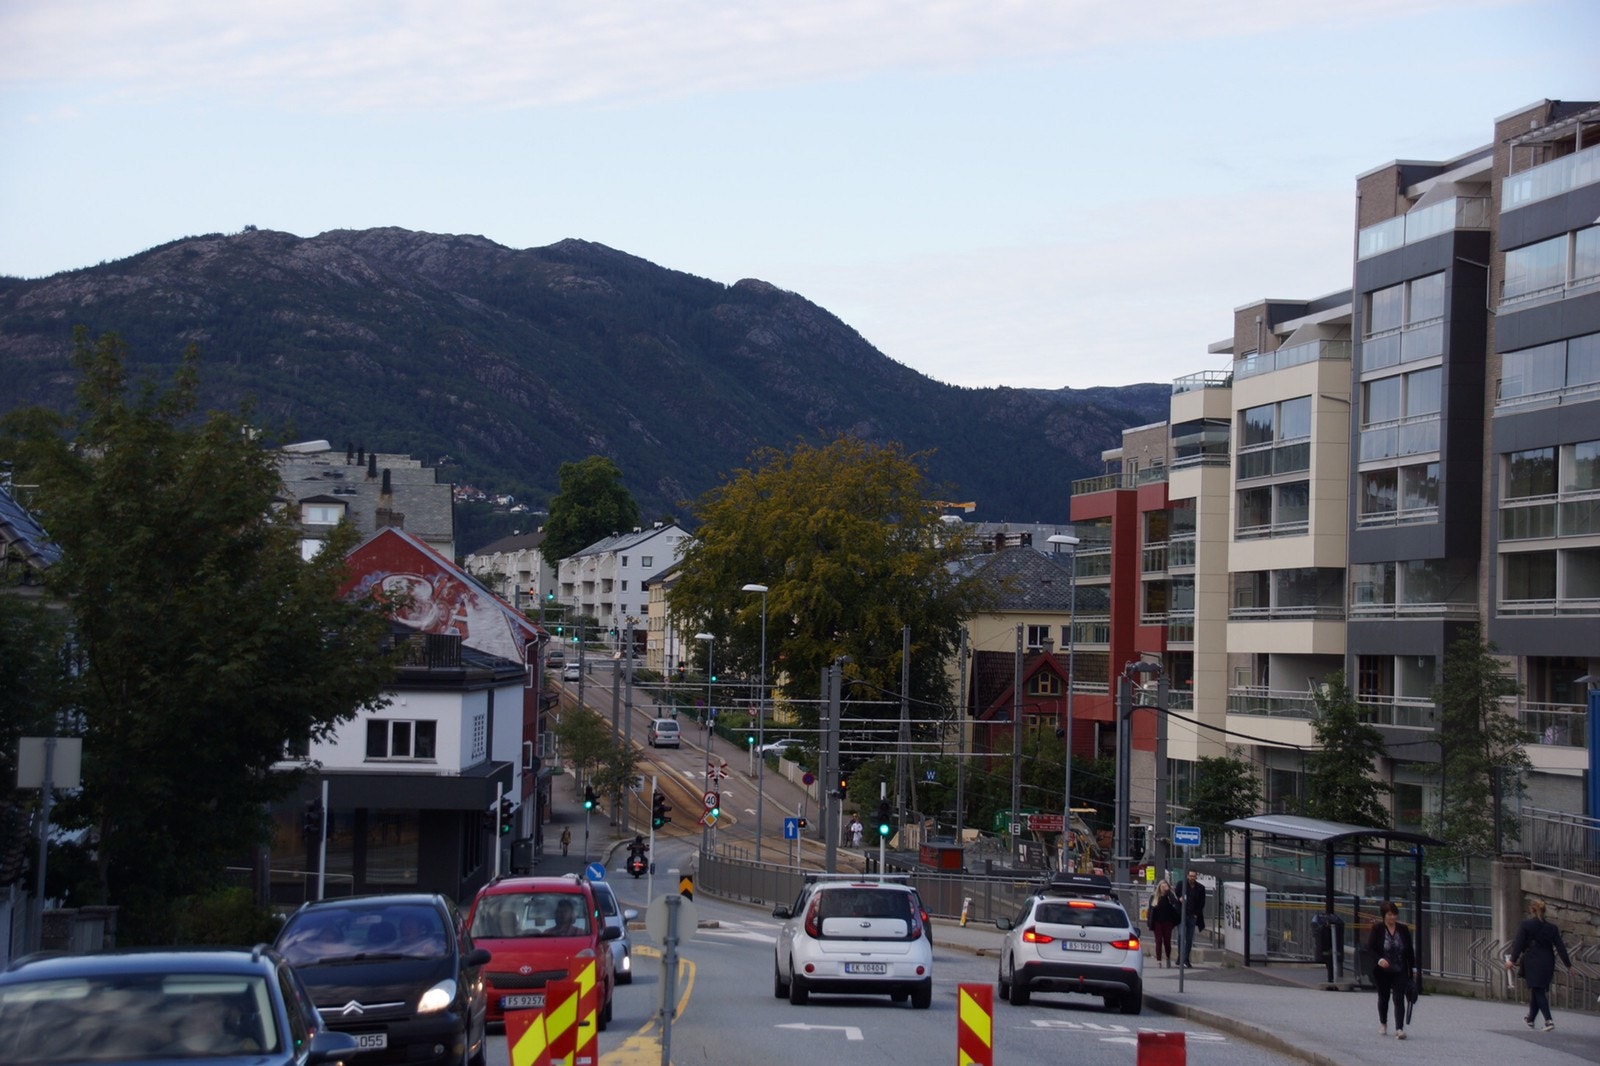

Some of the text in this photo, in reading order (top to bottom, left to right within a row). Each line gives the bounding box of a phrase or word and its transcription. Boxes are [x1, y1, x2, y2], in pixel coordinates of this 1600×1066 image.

[706, 796, 716, 805] 40
[1013, 824, 1020, 834] E
[508, 997, 518, 1005] FS
[354, 1035, 384, 1047] 055
